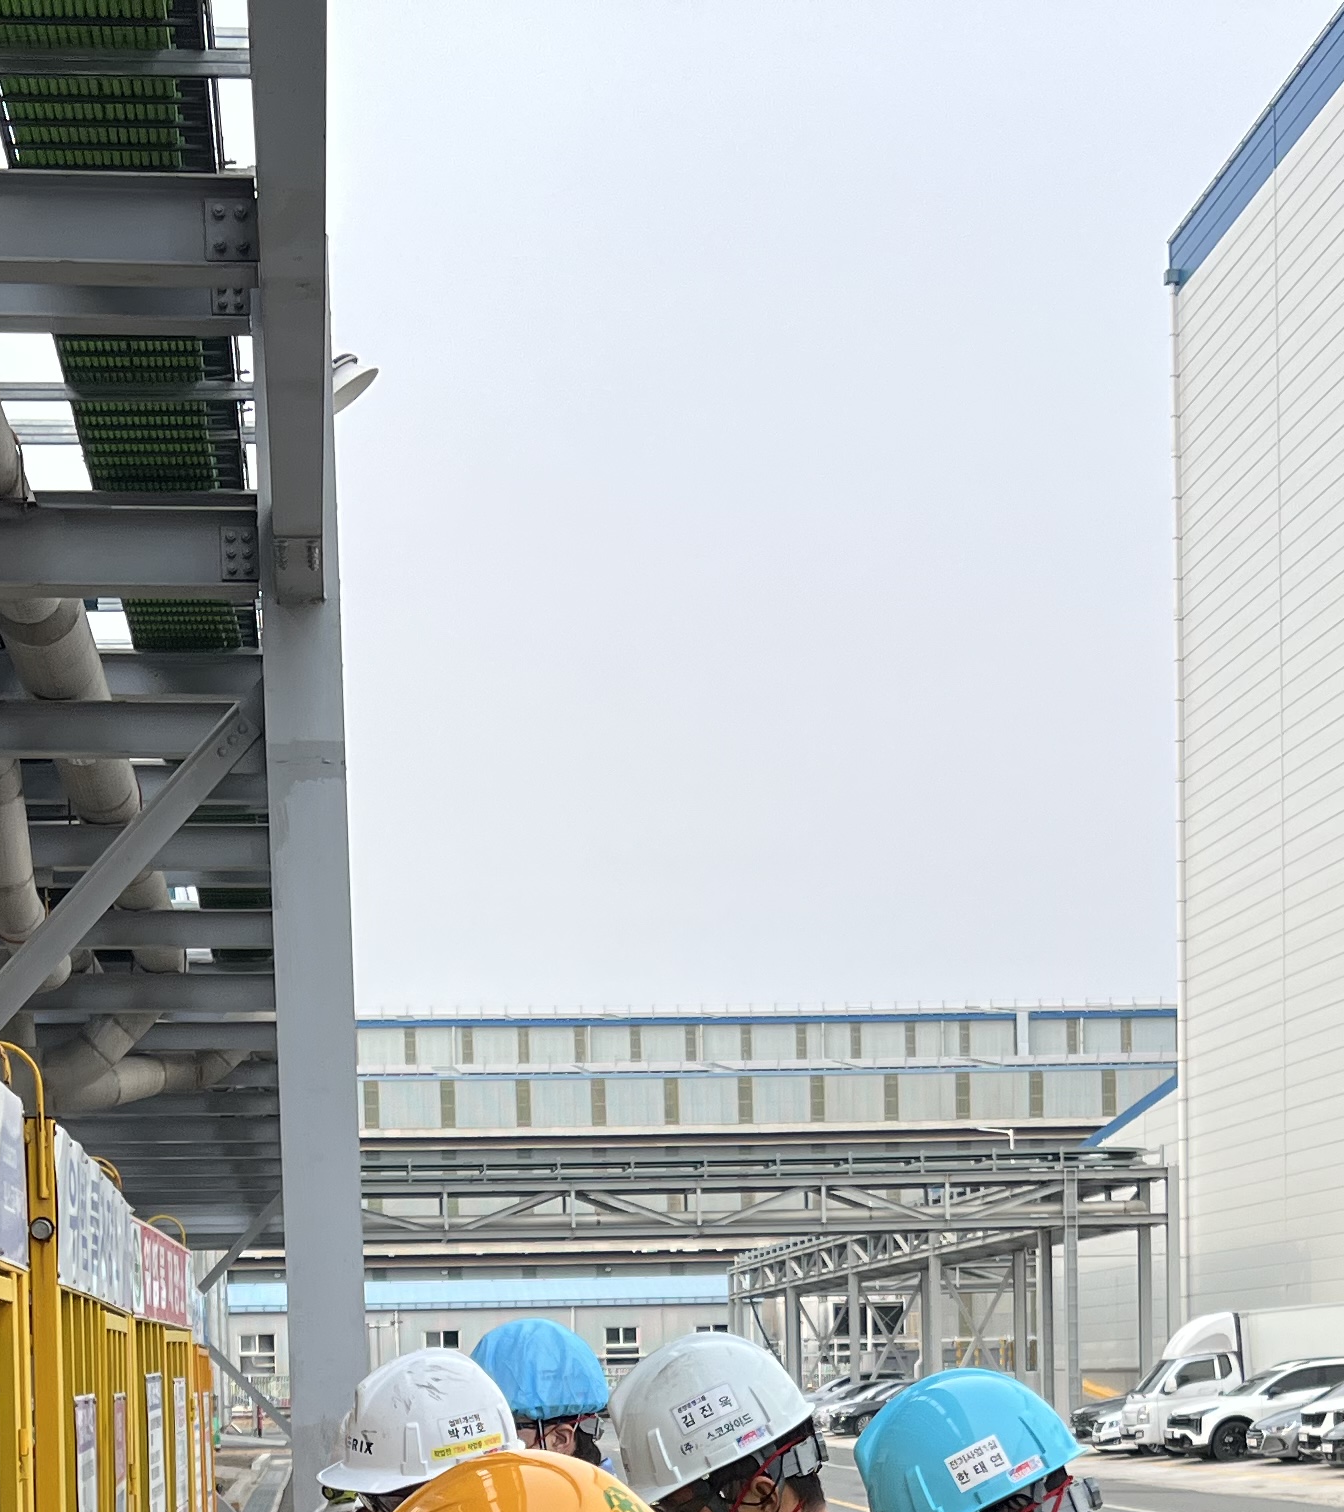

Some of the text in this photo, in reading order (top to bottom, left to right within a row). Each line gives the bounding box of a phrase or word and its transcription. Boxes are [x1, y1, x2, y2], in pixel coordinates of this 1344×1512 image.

[681, 1415, 696, 1428] 김
[699, 1403, 715, 1418] 진
[464, 1425, 474, 1437] 지
[956, 1452, 1006, 1485] 한 태 연
